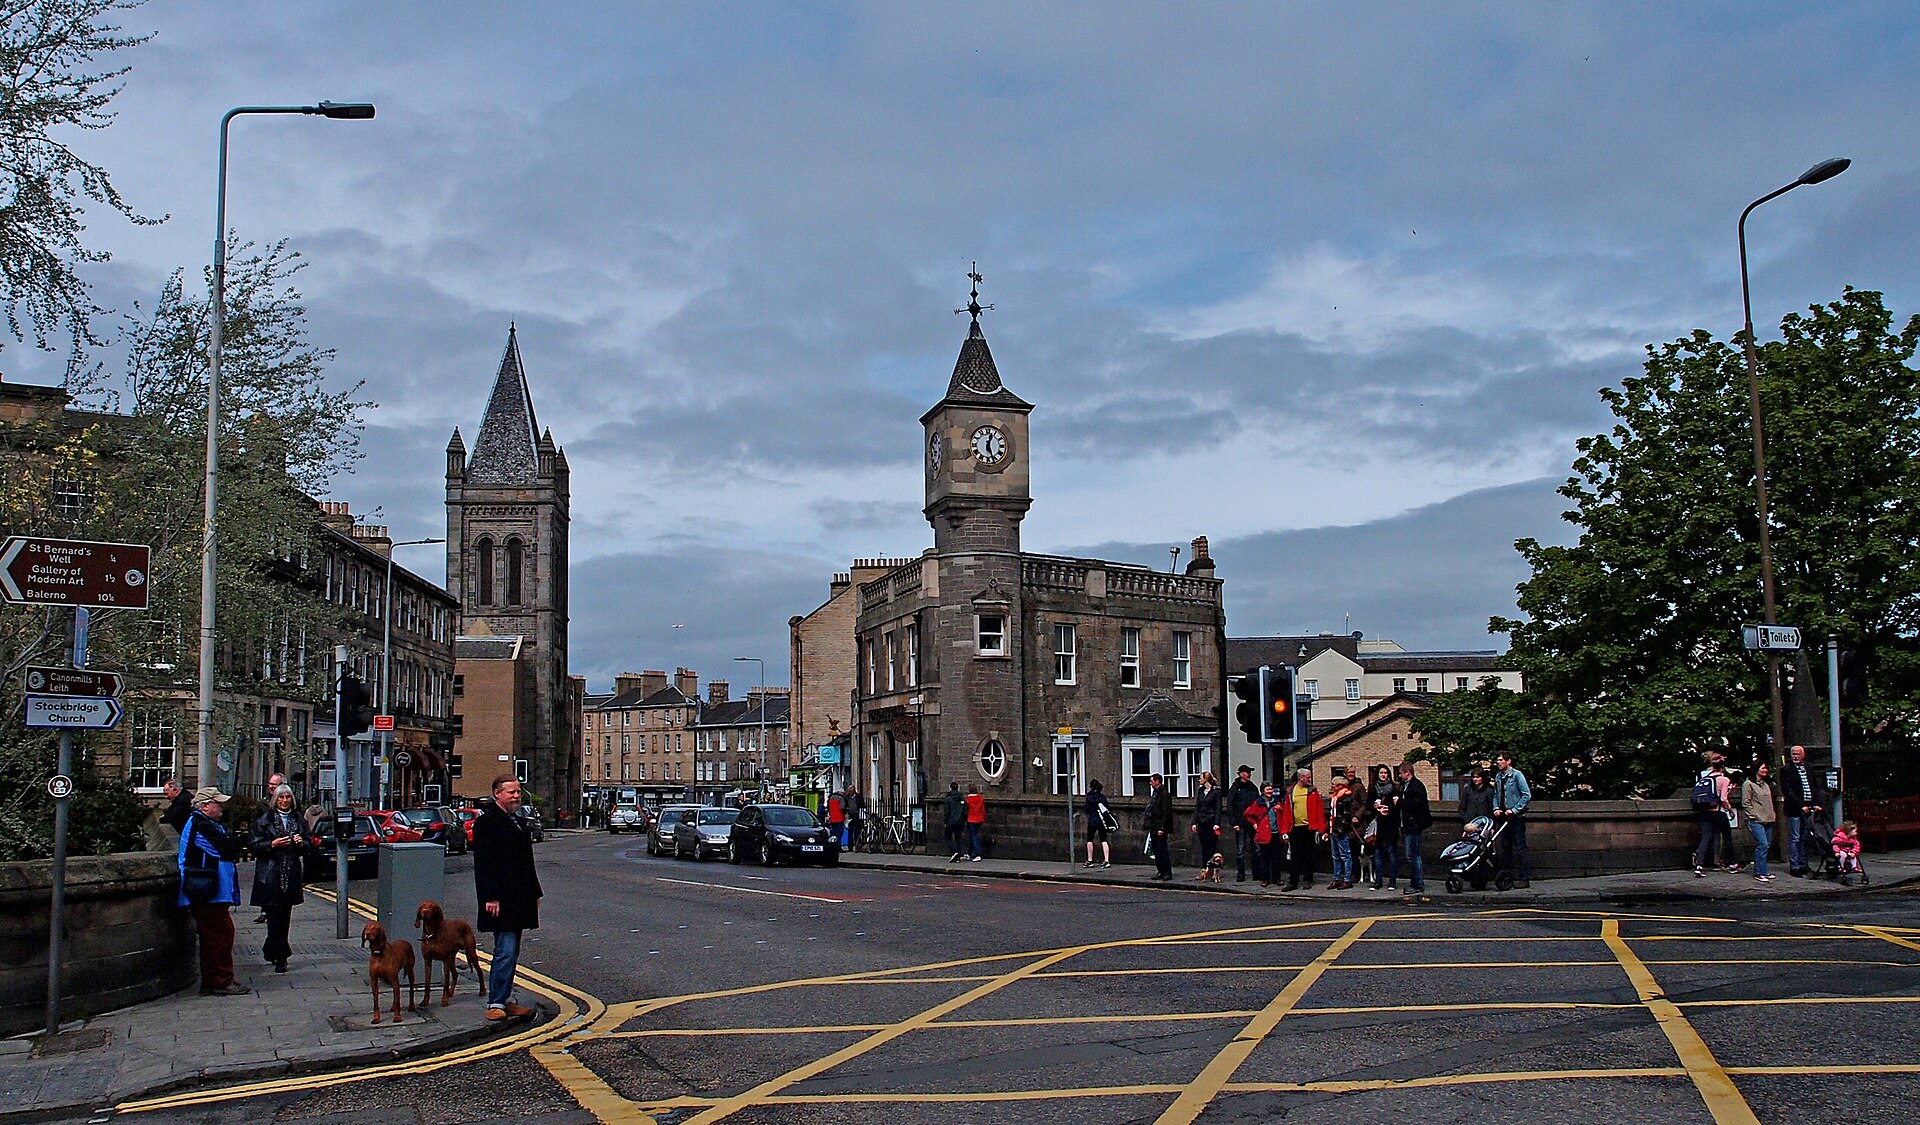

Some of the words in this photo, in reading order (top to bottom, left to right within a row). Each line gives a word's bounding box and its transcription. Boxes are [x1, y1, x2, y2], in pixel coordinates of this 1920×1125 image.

[29, 544, 41, 553] St
[44, 544, 92, 556] Bernard's
[49, 554, 72, 564] Well
[31, 564, 69, 576] Gallery
[70, 567, 82, 576] of
[27, 574, 66, 585] Modern
[68, 576, 84, 586] Art
[26, 589, 67, 600] Balerno
[1769, 632, 1795, 642] Toilets
[50, 672, 93, 684] Canonmills
[49, 683, 69, 692] Leith
[34, 702, 99, 713] Stockbridge
[48, 713, 86, 723] Church
